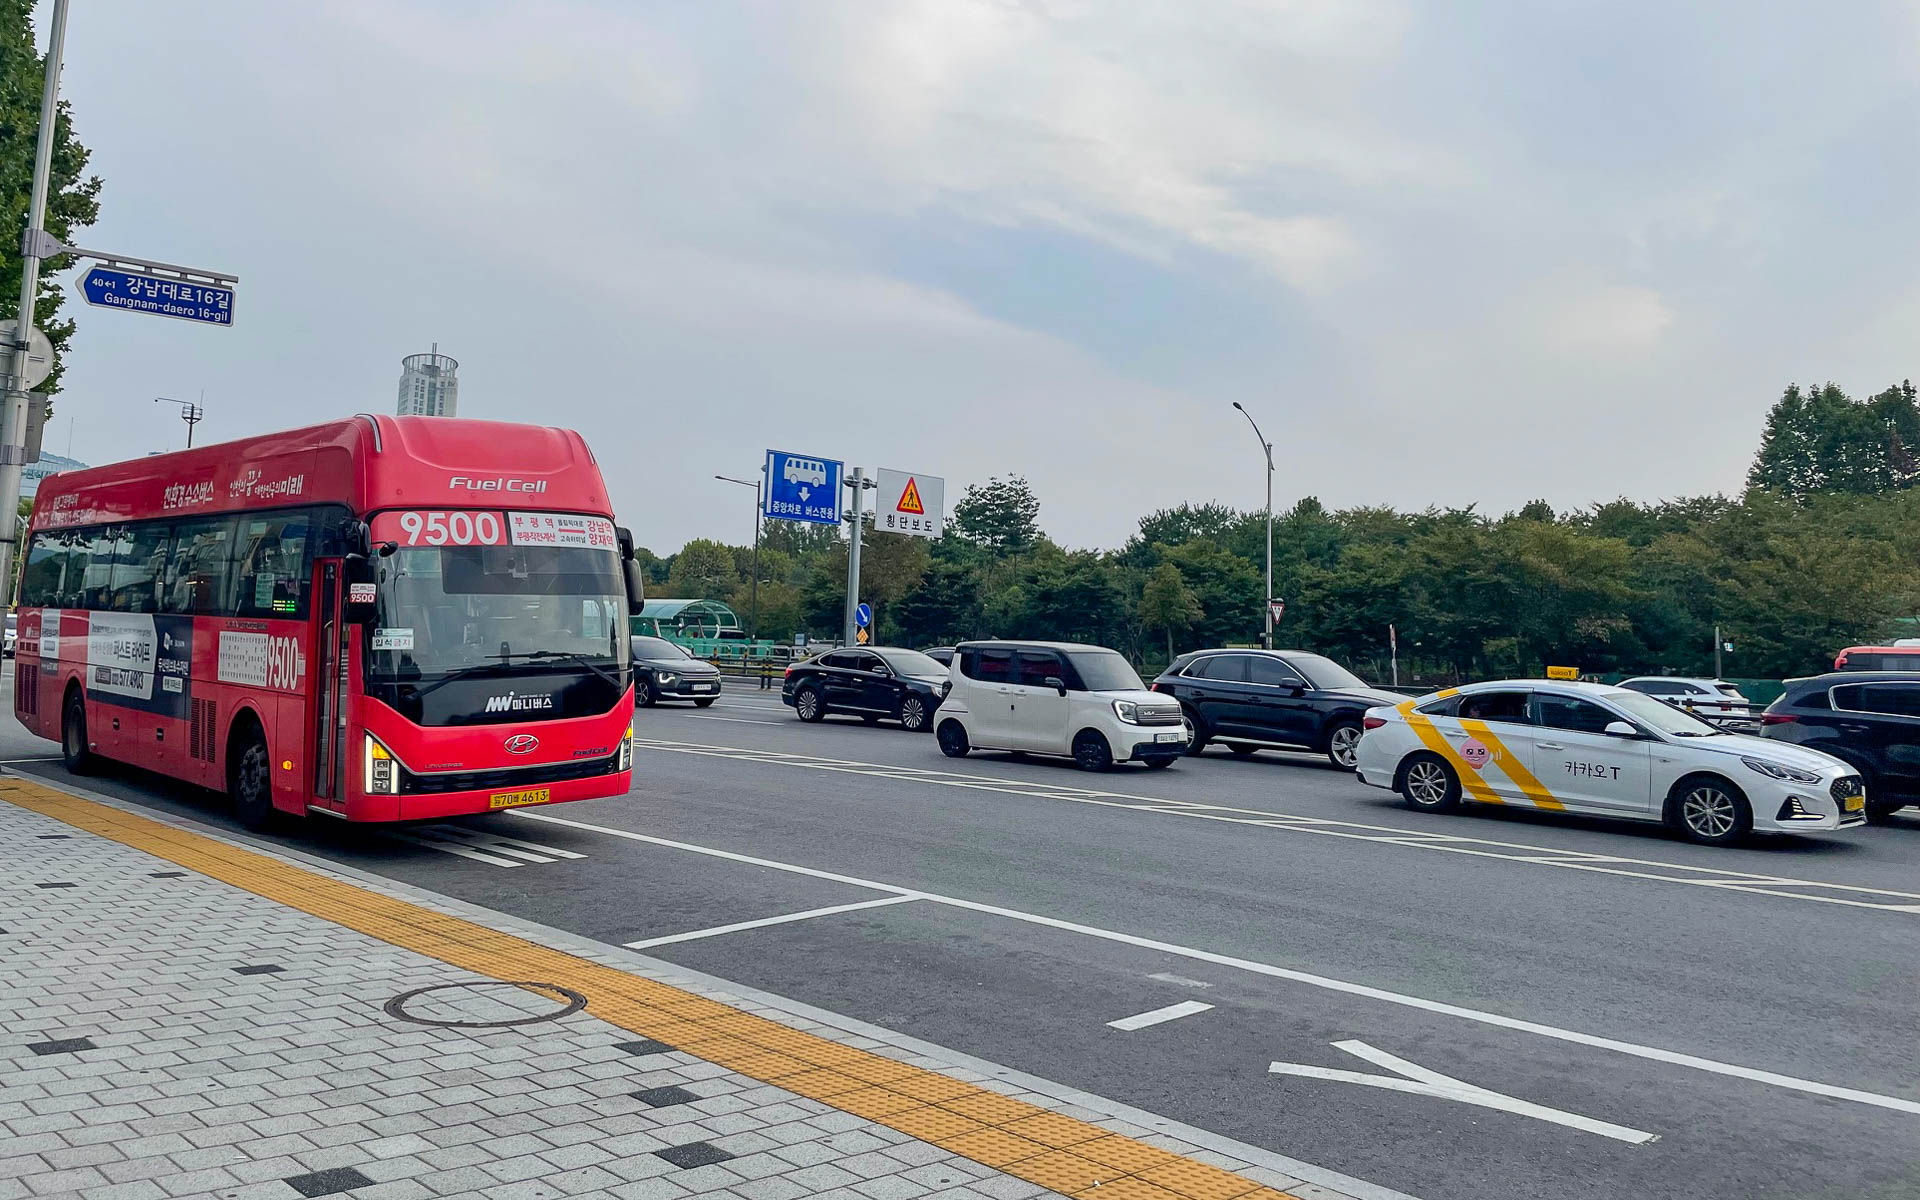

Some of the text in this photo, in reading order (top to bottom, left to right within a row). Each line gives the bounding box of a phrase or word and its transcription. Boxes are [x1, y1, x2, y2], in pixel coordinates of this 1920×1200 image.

[126, 277, 229, 310] 강남대로16길
[104, 292, 228, 322] Gangnam-daero 16-gil
[280, 474, 304, 496] 미래
[449, 476, 547, 493] Fuel Cell
[772, 500, 835, 520] 중앙차로 버스전용
[400, 511, 499, 546] 9500
[587, 520, 612, 534] 강남역
[886, 514, 933, 532] 횡단보도
[588, 533, 614, 547] 양재역
[351, 593, 375, 603] 9500
[268, 635, 298, 690] 9500
[512, 697, 552, 711] 마니버스
[1565, 761, 1621, 780] 카카오 T
[521, 790, 546, 802] 4613
